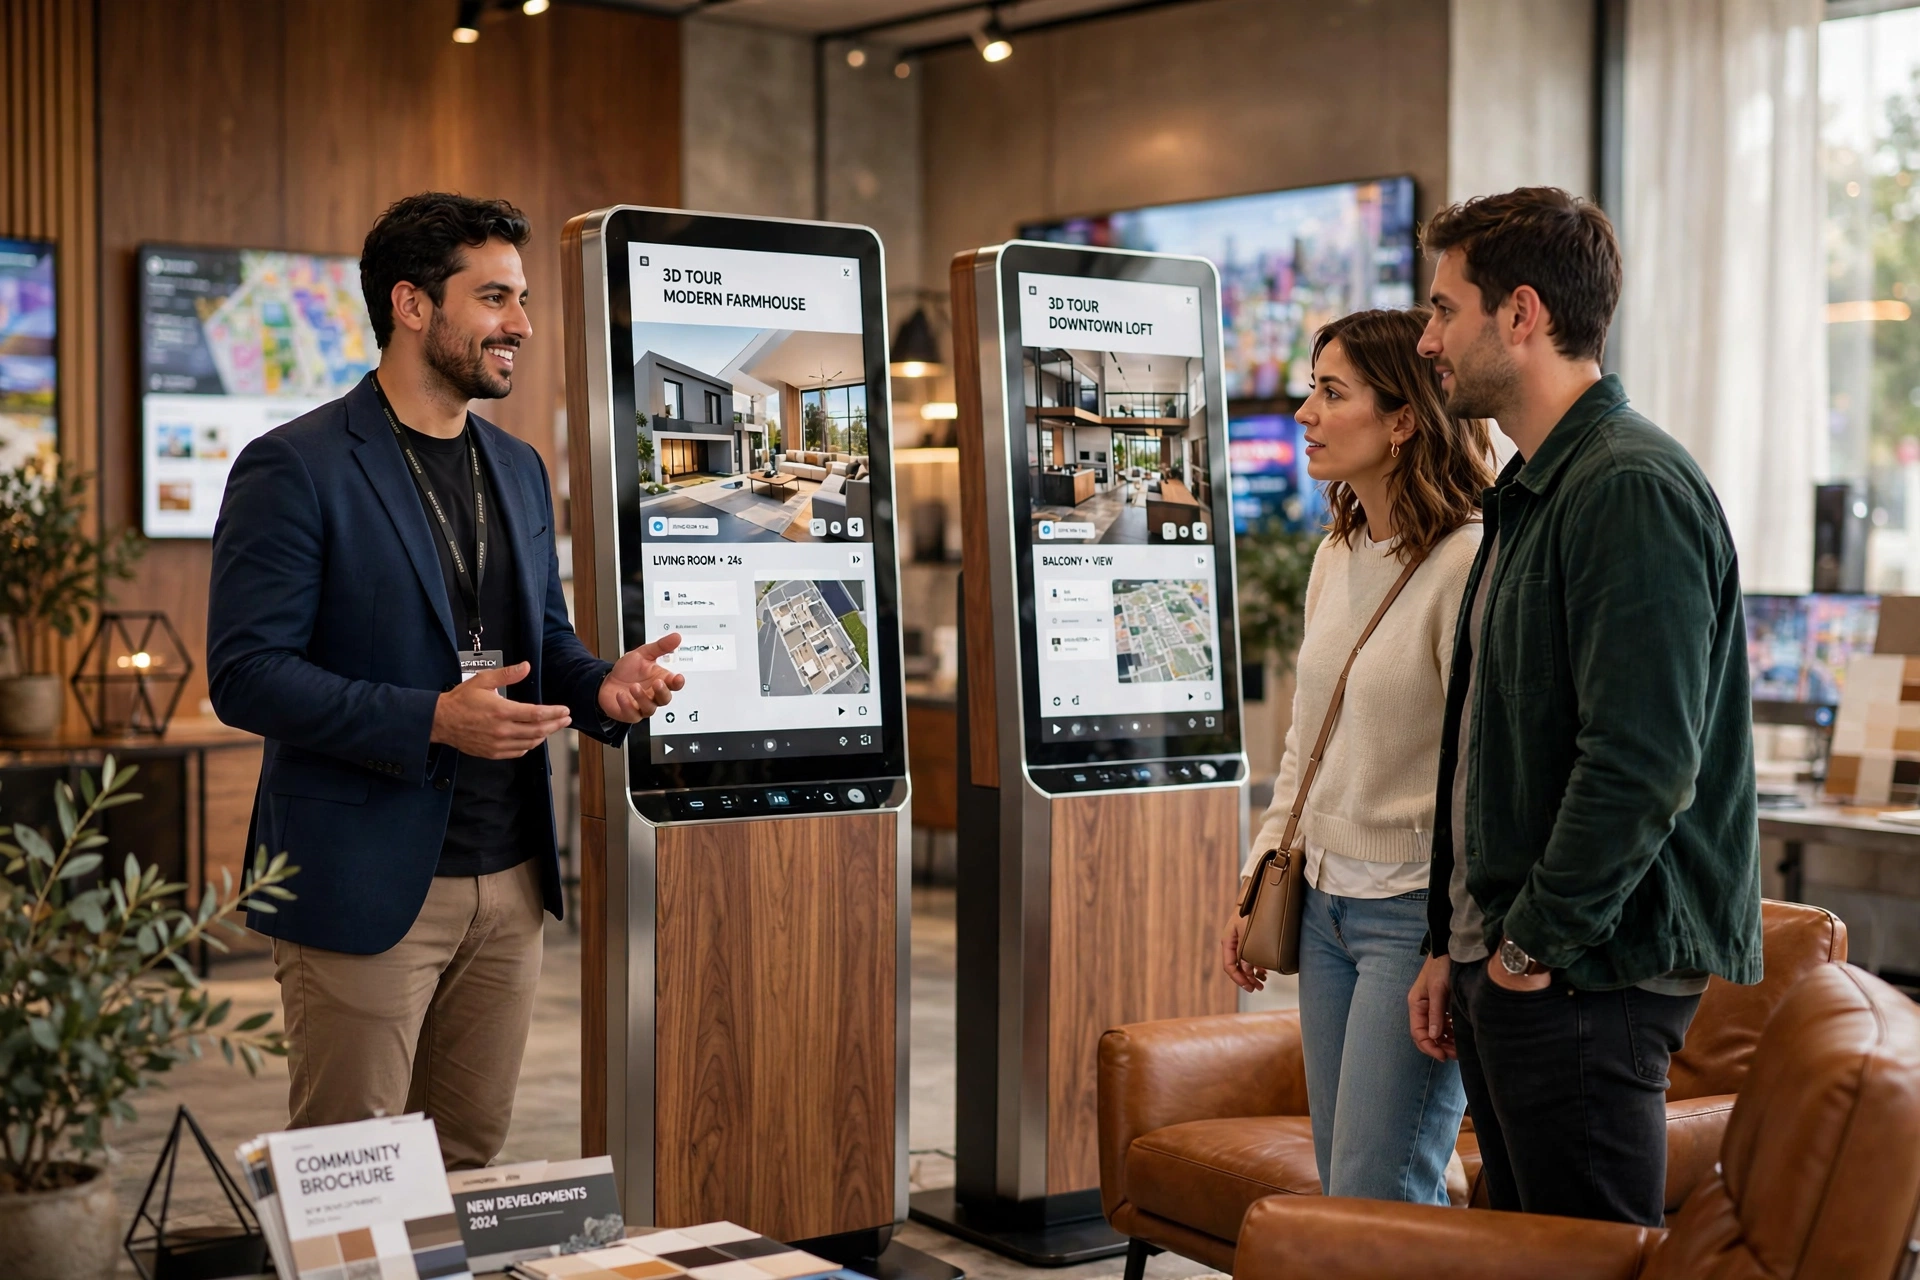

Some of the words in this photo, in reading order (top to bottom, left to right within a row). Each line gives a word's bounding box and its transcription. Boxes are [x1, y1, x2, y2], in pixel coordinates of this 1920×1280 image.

[663, 268, 682, 283] 3D
[685, 270, 722, 285] TOUR
[663, 289, 723, 305] MODERN
[726, 293, 806, 310] FARMHOUSE
[1048, 296, 1064, 310] 3D
[1067, 298, 1099, 313] TOUR
[1049, 316, 1123, 333] DOWNTOWN
[1126, 322, 1153, 335] LOFT
[653, 555, 686, 566] LIVING
[687, 555, 716, 566] ROOM
[727, 555, 743, 566] 24s
[1042, 556, 1083, 566] BALCONY
[1092, 556, 1113, 566] VIEW
[296, 1143, 400, 1174] COMMUNITY
[300, 1165, 395, 1195] BROCHURE
[466, 1197, 495, 1214] NEW
[497, 1186, 587, 1210] DEVELOPMENTS
[469, 1215, 499, 1230] 2024
